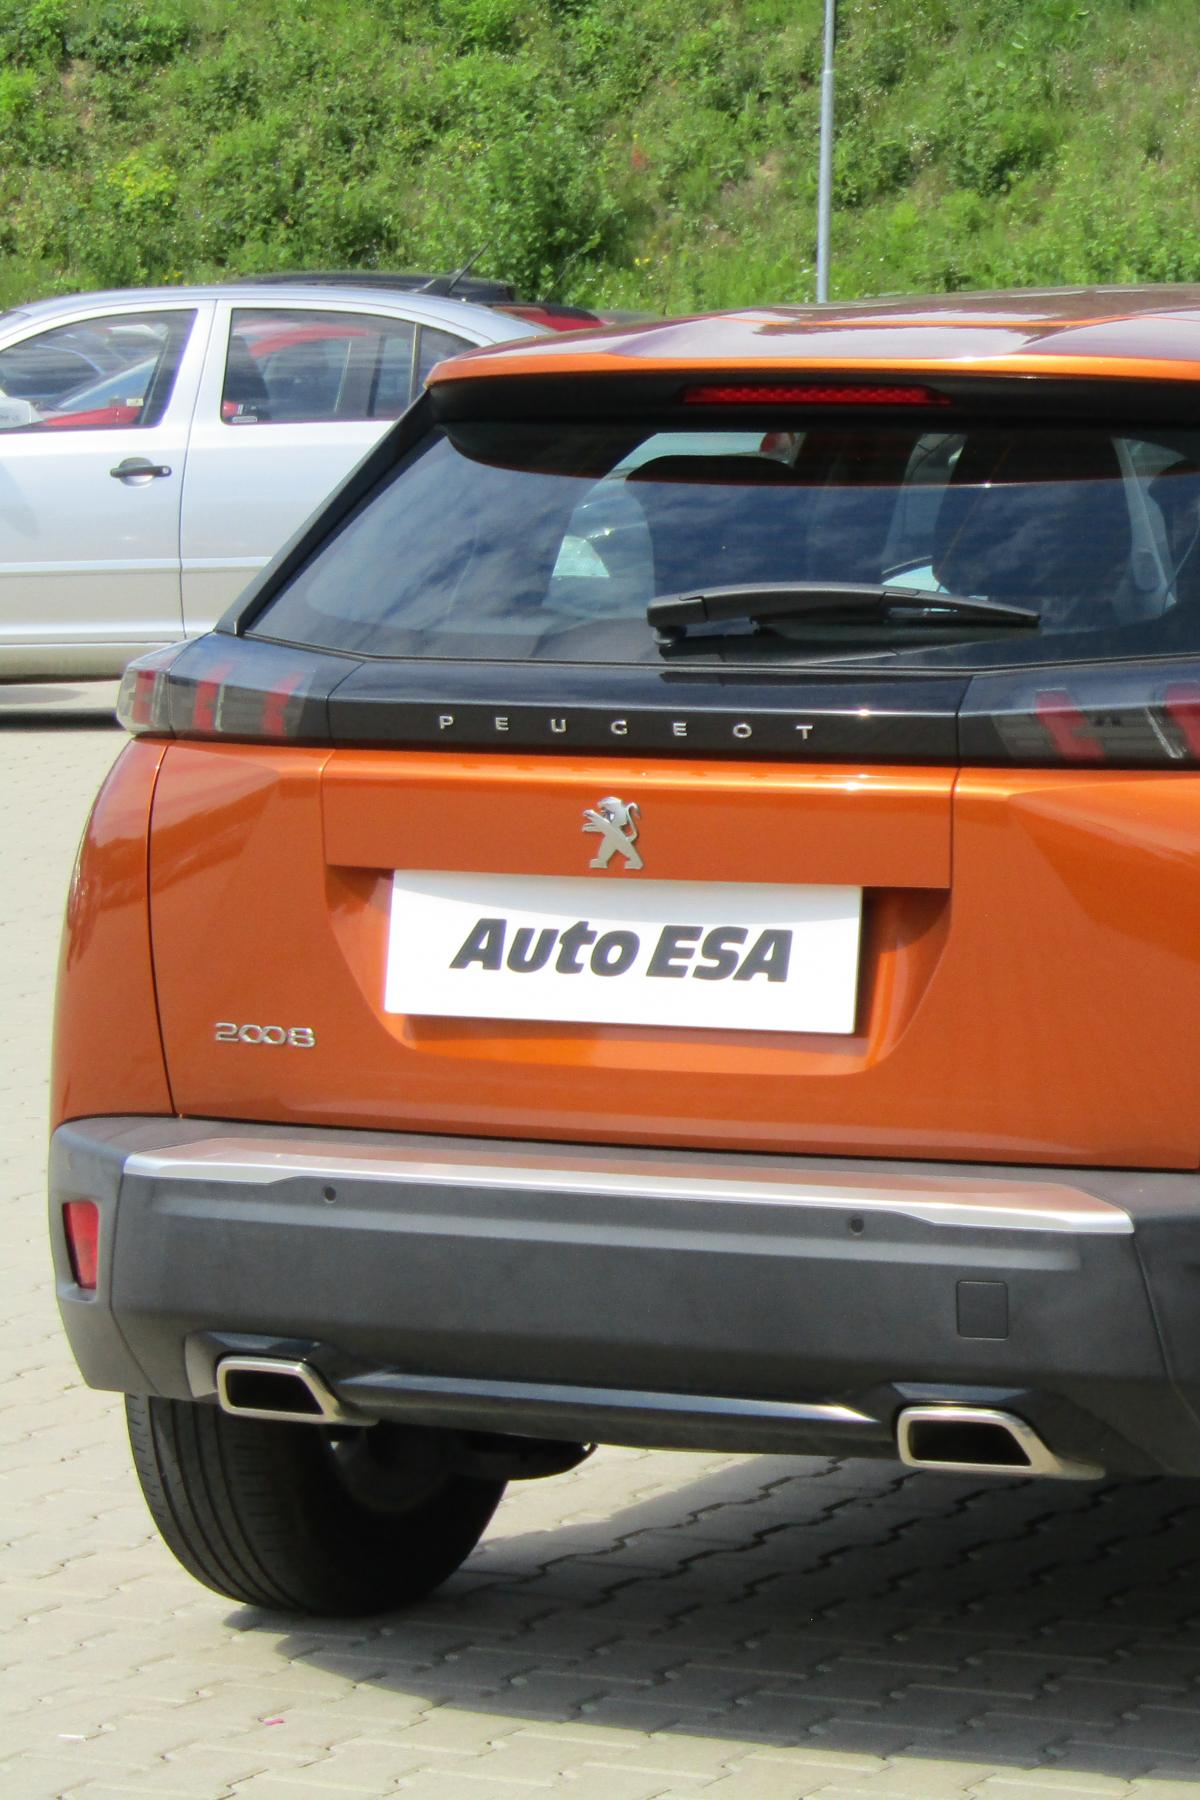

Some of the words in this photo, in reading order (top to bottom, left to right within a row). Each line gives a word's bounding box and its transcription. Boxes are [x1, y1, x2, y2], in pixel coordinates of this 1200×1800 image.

[438, 715, 814, 740] PEUGEOT
[450, 918, 641, 977] Auto
[647, 926, 794, 983] ESA
[214, 1022, 316, 1048] 2008
